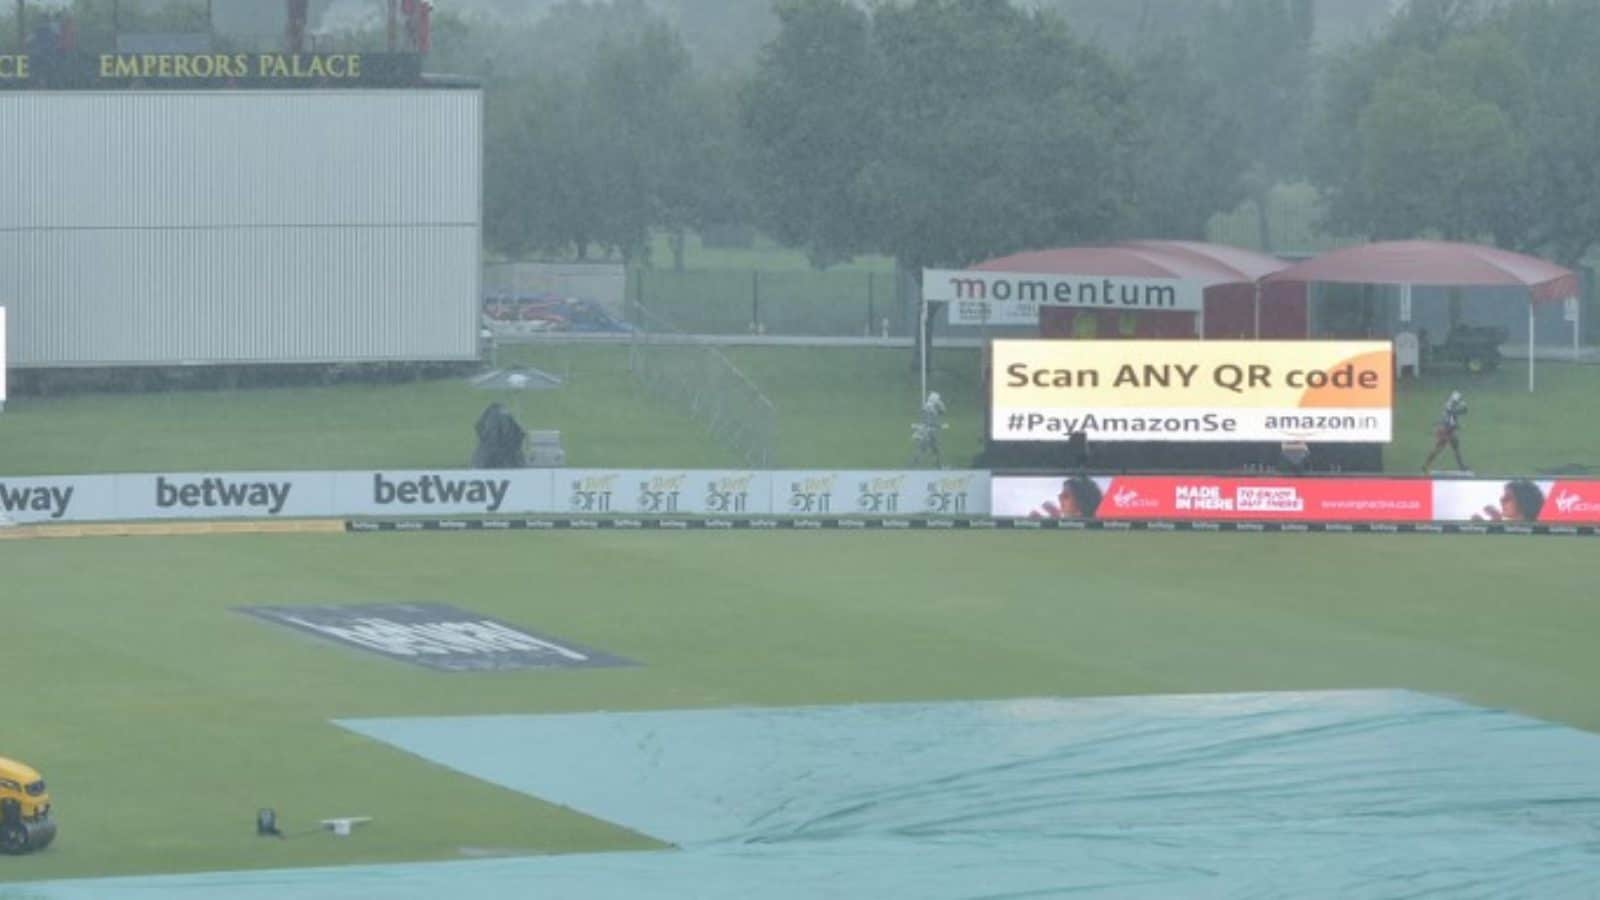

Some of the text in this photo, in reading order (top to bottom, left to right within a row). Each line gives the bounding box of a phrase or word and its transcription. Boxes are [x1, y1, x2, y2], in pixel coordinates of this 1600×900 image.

[100, 54, 361, 78] EMPERORS PALACE
[950, 277, 1176, 307] momentum
[1006, 362, 1379, 394] Scan ANY QR code
[1007, 412, 1238, 435] #PayAmazonSe
[156, 476, 292, 514] betway
[373, 473, 510, 511] betway
